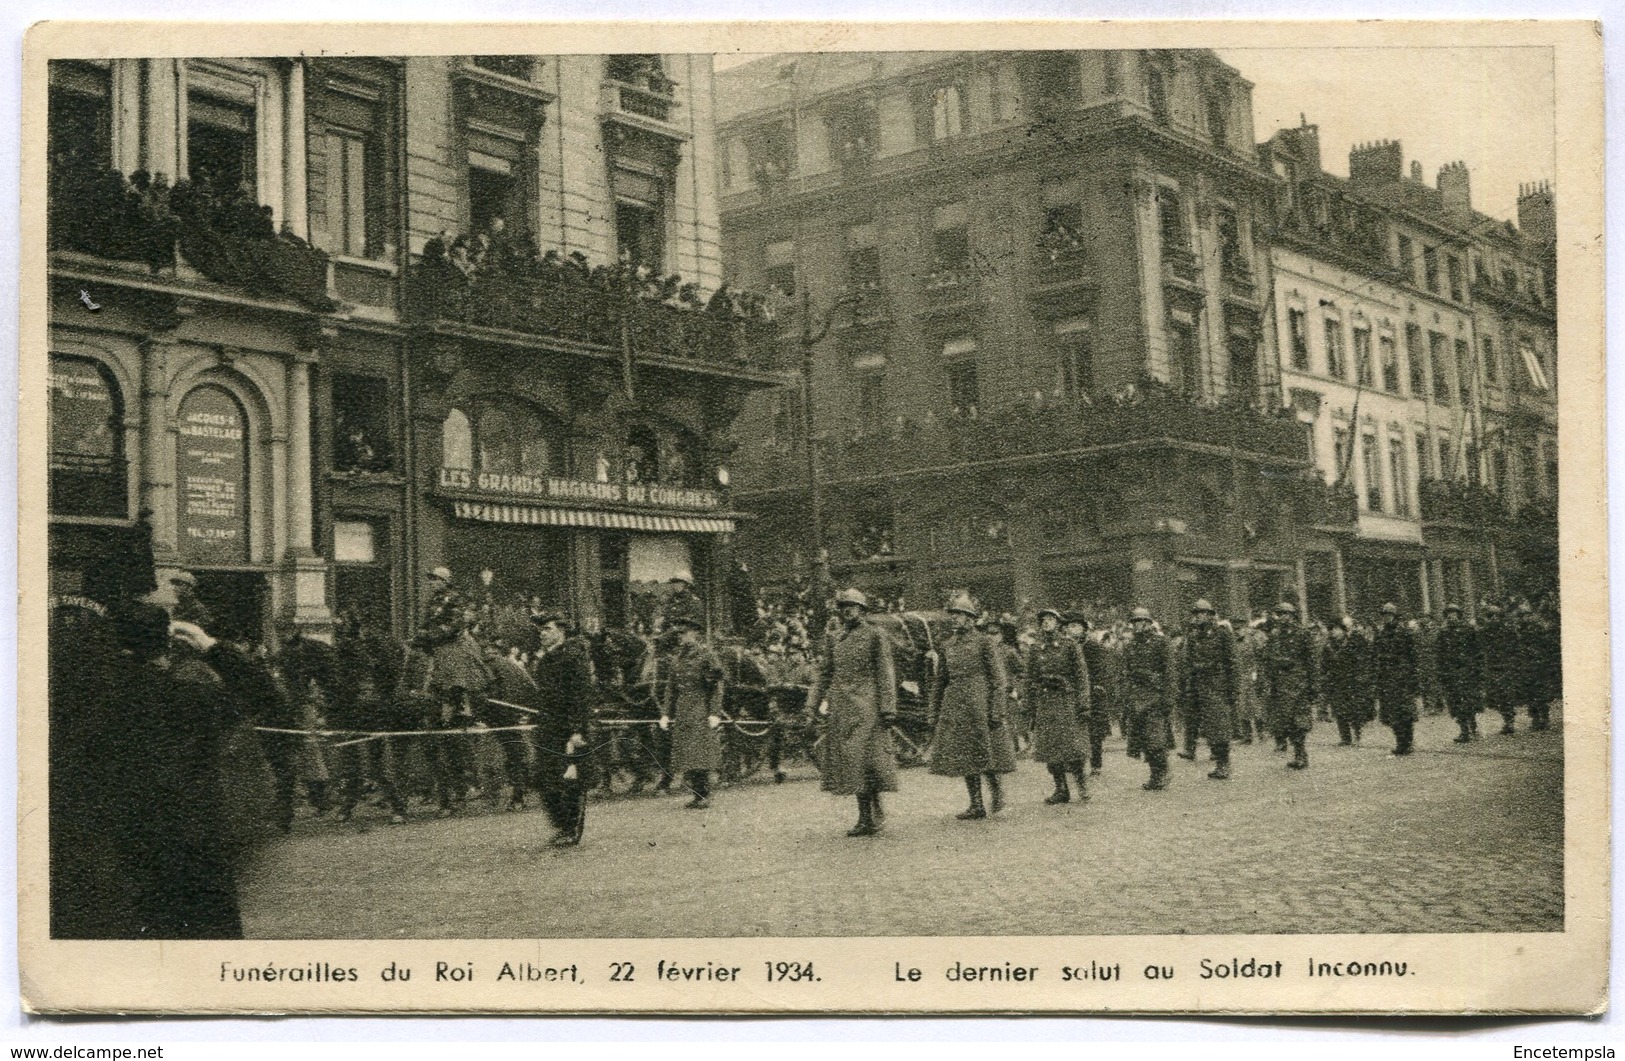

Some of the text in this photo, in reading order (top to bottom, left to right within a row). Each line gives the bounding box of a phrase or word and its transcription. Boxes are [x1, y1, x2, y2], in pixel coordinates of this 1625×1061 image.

[440, 468, 471, 488] LES
[478, 472, 543, 494] GRANDS
[548, 477, 622, 500] MAGASINS
[627, 485, 646, 502] DU
